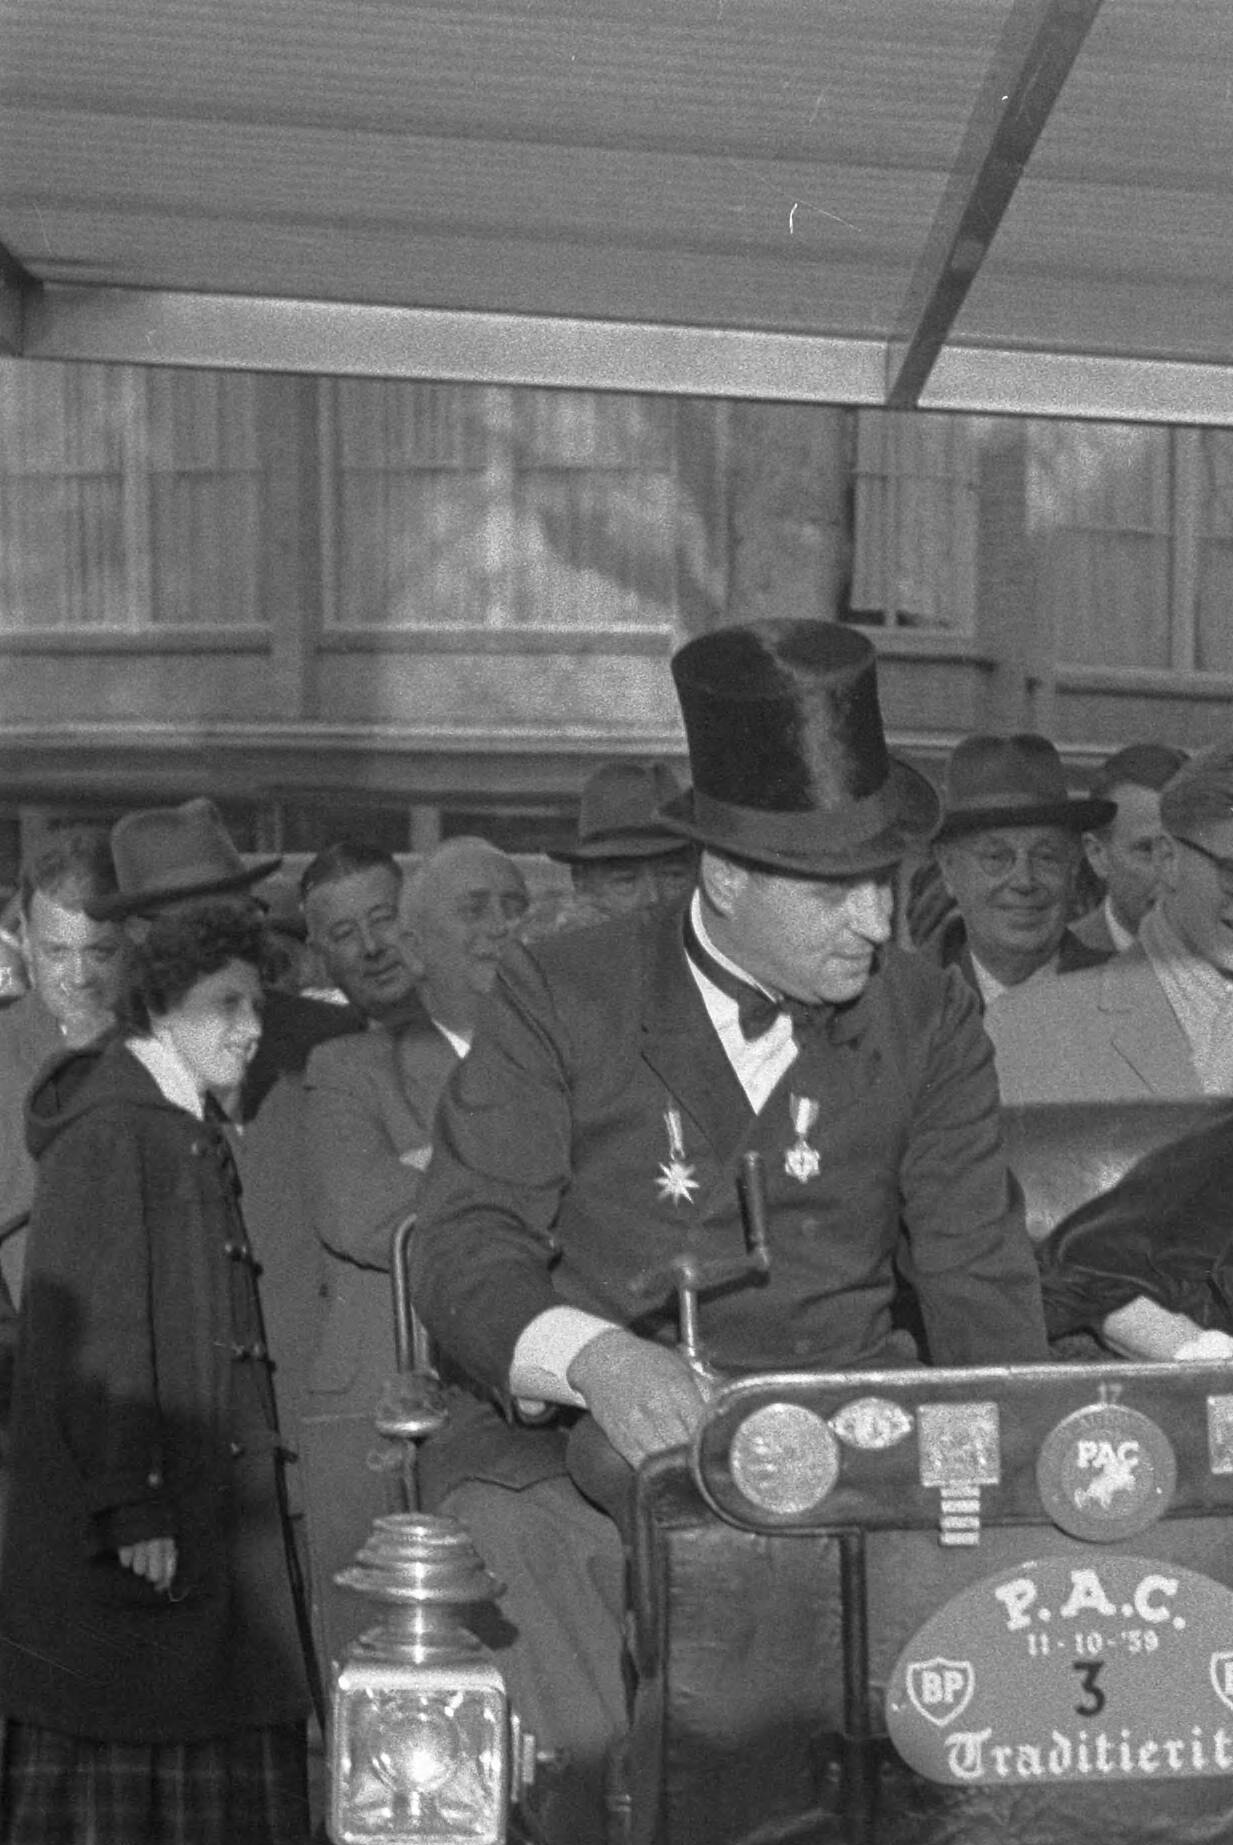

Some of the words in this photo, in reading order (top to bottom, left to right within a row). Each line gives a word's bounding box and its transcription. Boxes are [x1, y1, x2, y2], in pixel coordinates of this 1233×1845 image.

[1076, 1439, 1140, 1469] PAC
[995, 1569, 1186, 1631] P.A.C.
[921, 1670, 963, 1704] BP
[1072, 1660, 1106, 1717] 3
